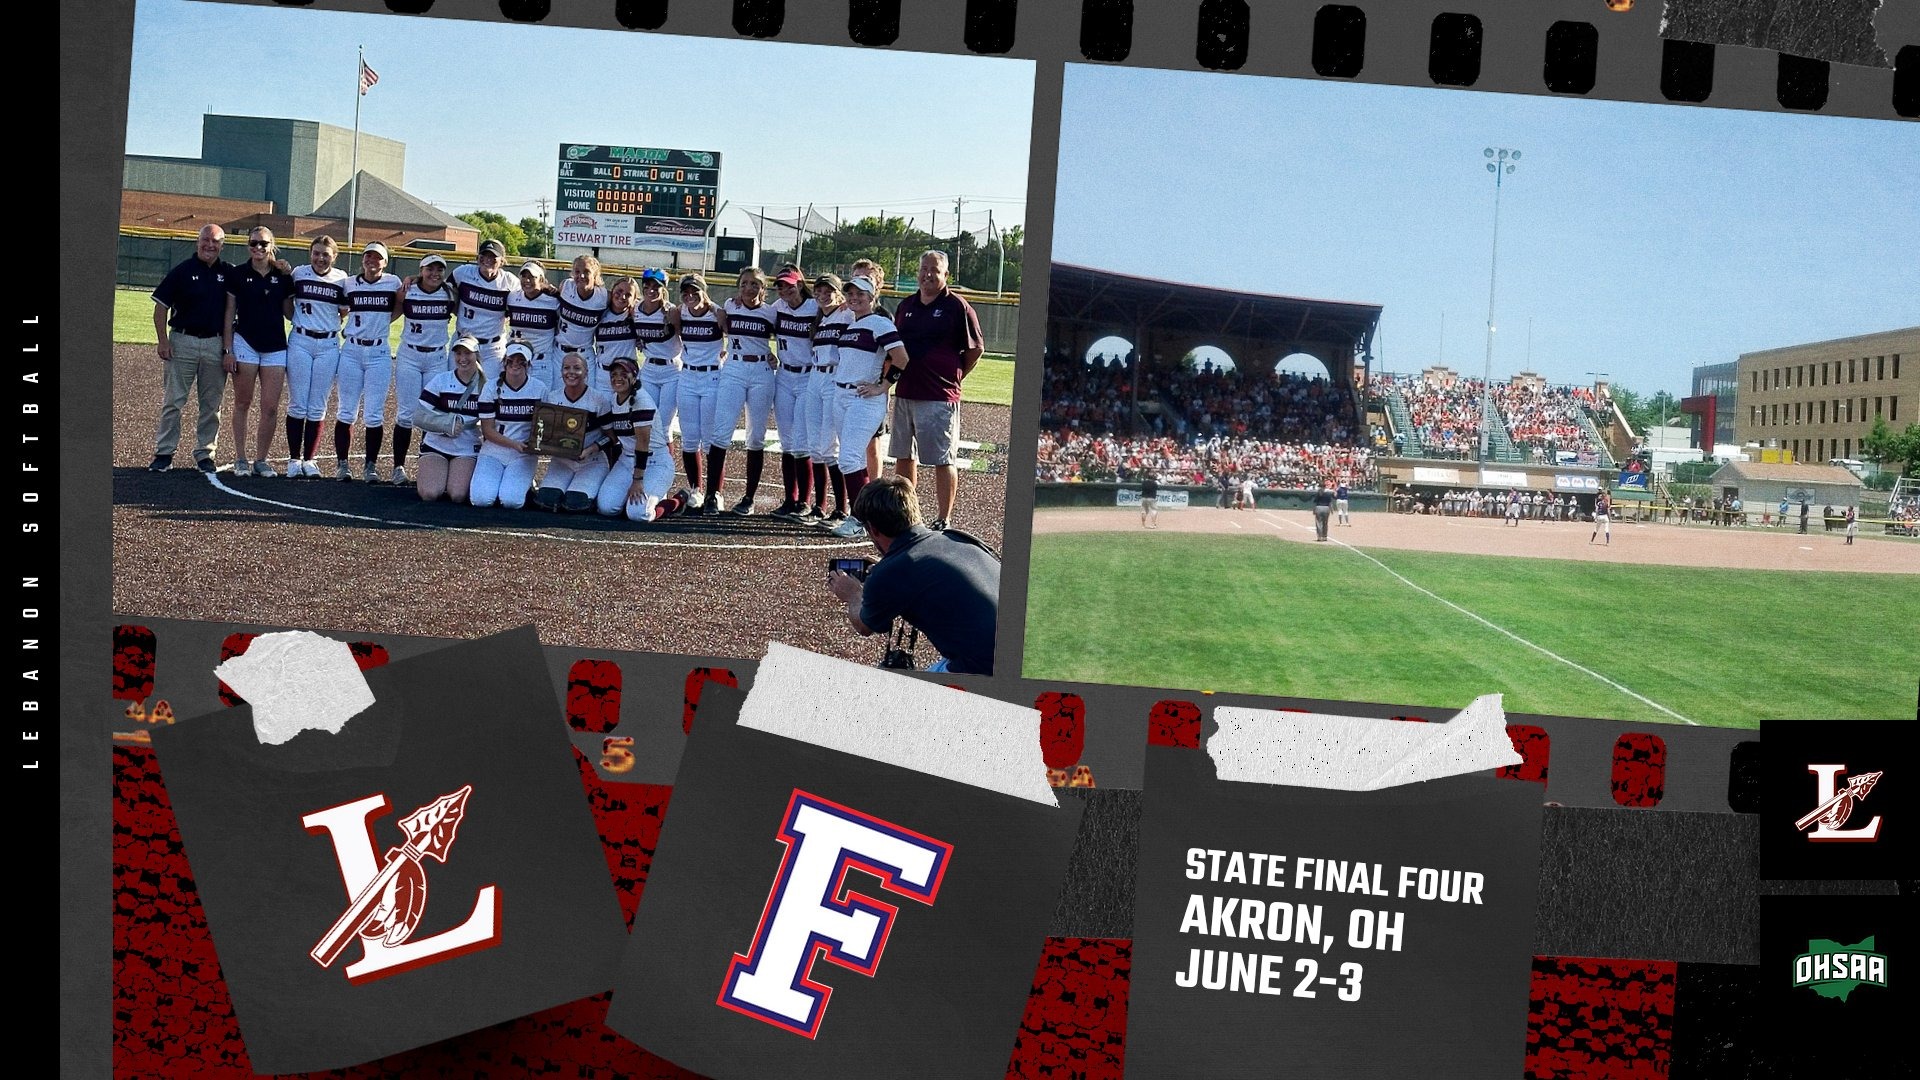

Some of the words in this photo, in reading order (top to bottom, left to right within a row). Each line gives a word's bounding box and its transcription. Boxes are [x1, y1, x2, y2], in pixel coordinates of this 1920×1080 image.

[609, 146, 671, 160] MASON
[593, 168, 612, 176] BALL
[623, 170, 649, 178] STRIKE
[660, 171, 675, 179] OUT
[564, 188, 596, 198] VISITOR
[568, 201, 590, 210] HOME
[558, 232, 607, 244] STEWART
[609, 235, 632, 245] TIRE
[303, 285, 338, 298] WARRIORS
[469, 290, 504, 305] WARRIORS
[354, 296, 388, 306] WARRIORS
[412, 305, 447, 314] WARRIORS
[464, 306, 475, 320] 13
[512, 312, 547, 324] WARRIORS
[561, 308, 598, 324] WARRIORS
[598, 325, 631, 335] WARRIORS
[682, 326, 713, 335] WARRIORS
[731, 320, 766, 332] WARRIORS
[780, 320, 811, 332] WARRIORS
[500, 405, 534, 414] WARRIORS
